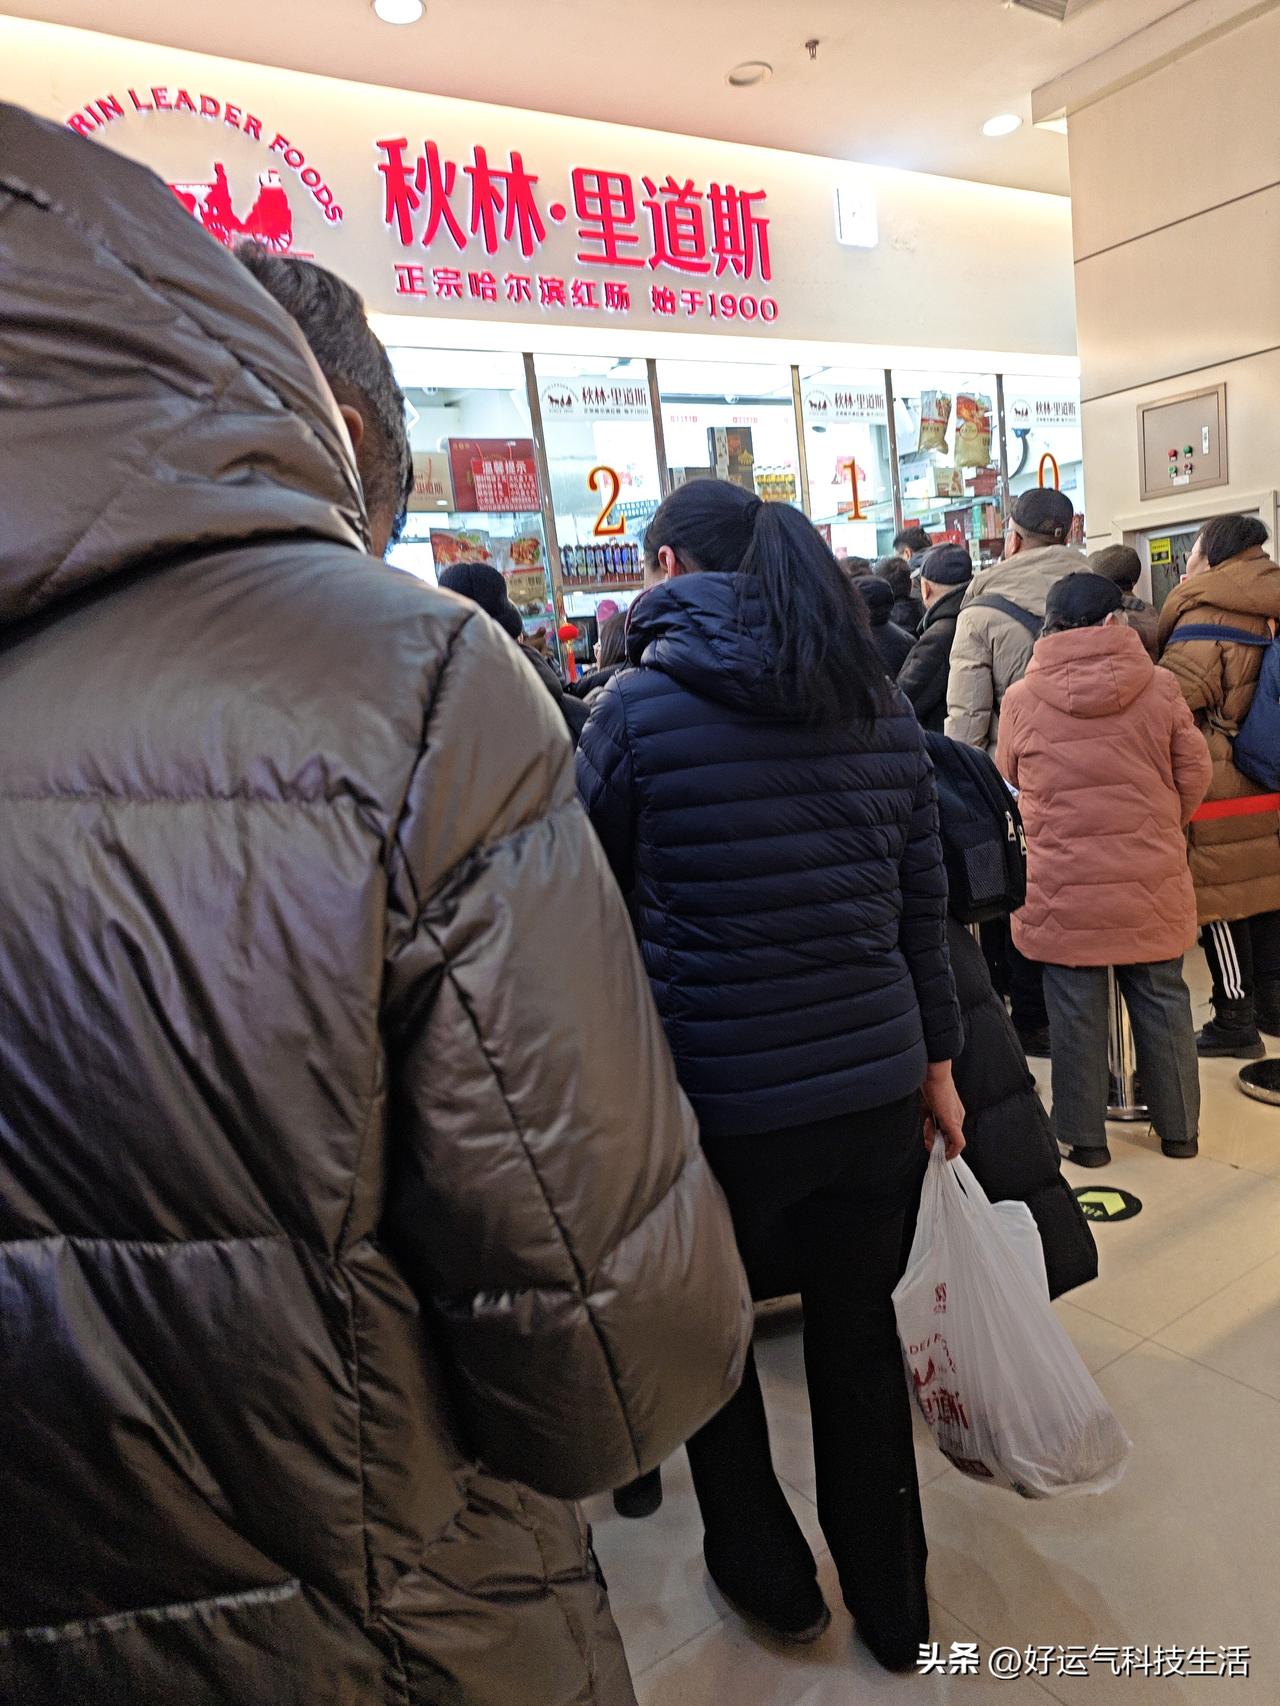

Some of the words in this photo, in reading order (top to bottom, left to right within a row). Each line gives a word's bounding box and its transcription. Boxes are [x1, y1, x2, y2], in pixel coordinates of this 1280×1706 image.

[128, 86, 263, 140] LEADER
[264, 132, 344, 223] FOODS
[376, 137, 772, 282] 秋林·里道斯
[394, 264, 632, 311] 正宗哈尔滨红肠
[651, 285, 779, 321] 始于1900
[587, 465, 627, 537] 2
[843, 458, 867, 521] 1
